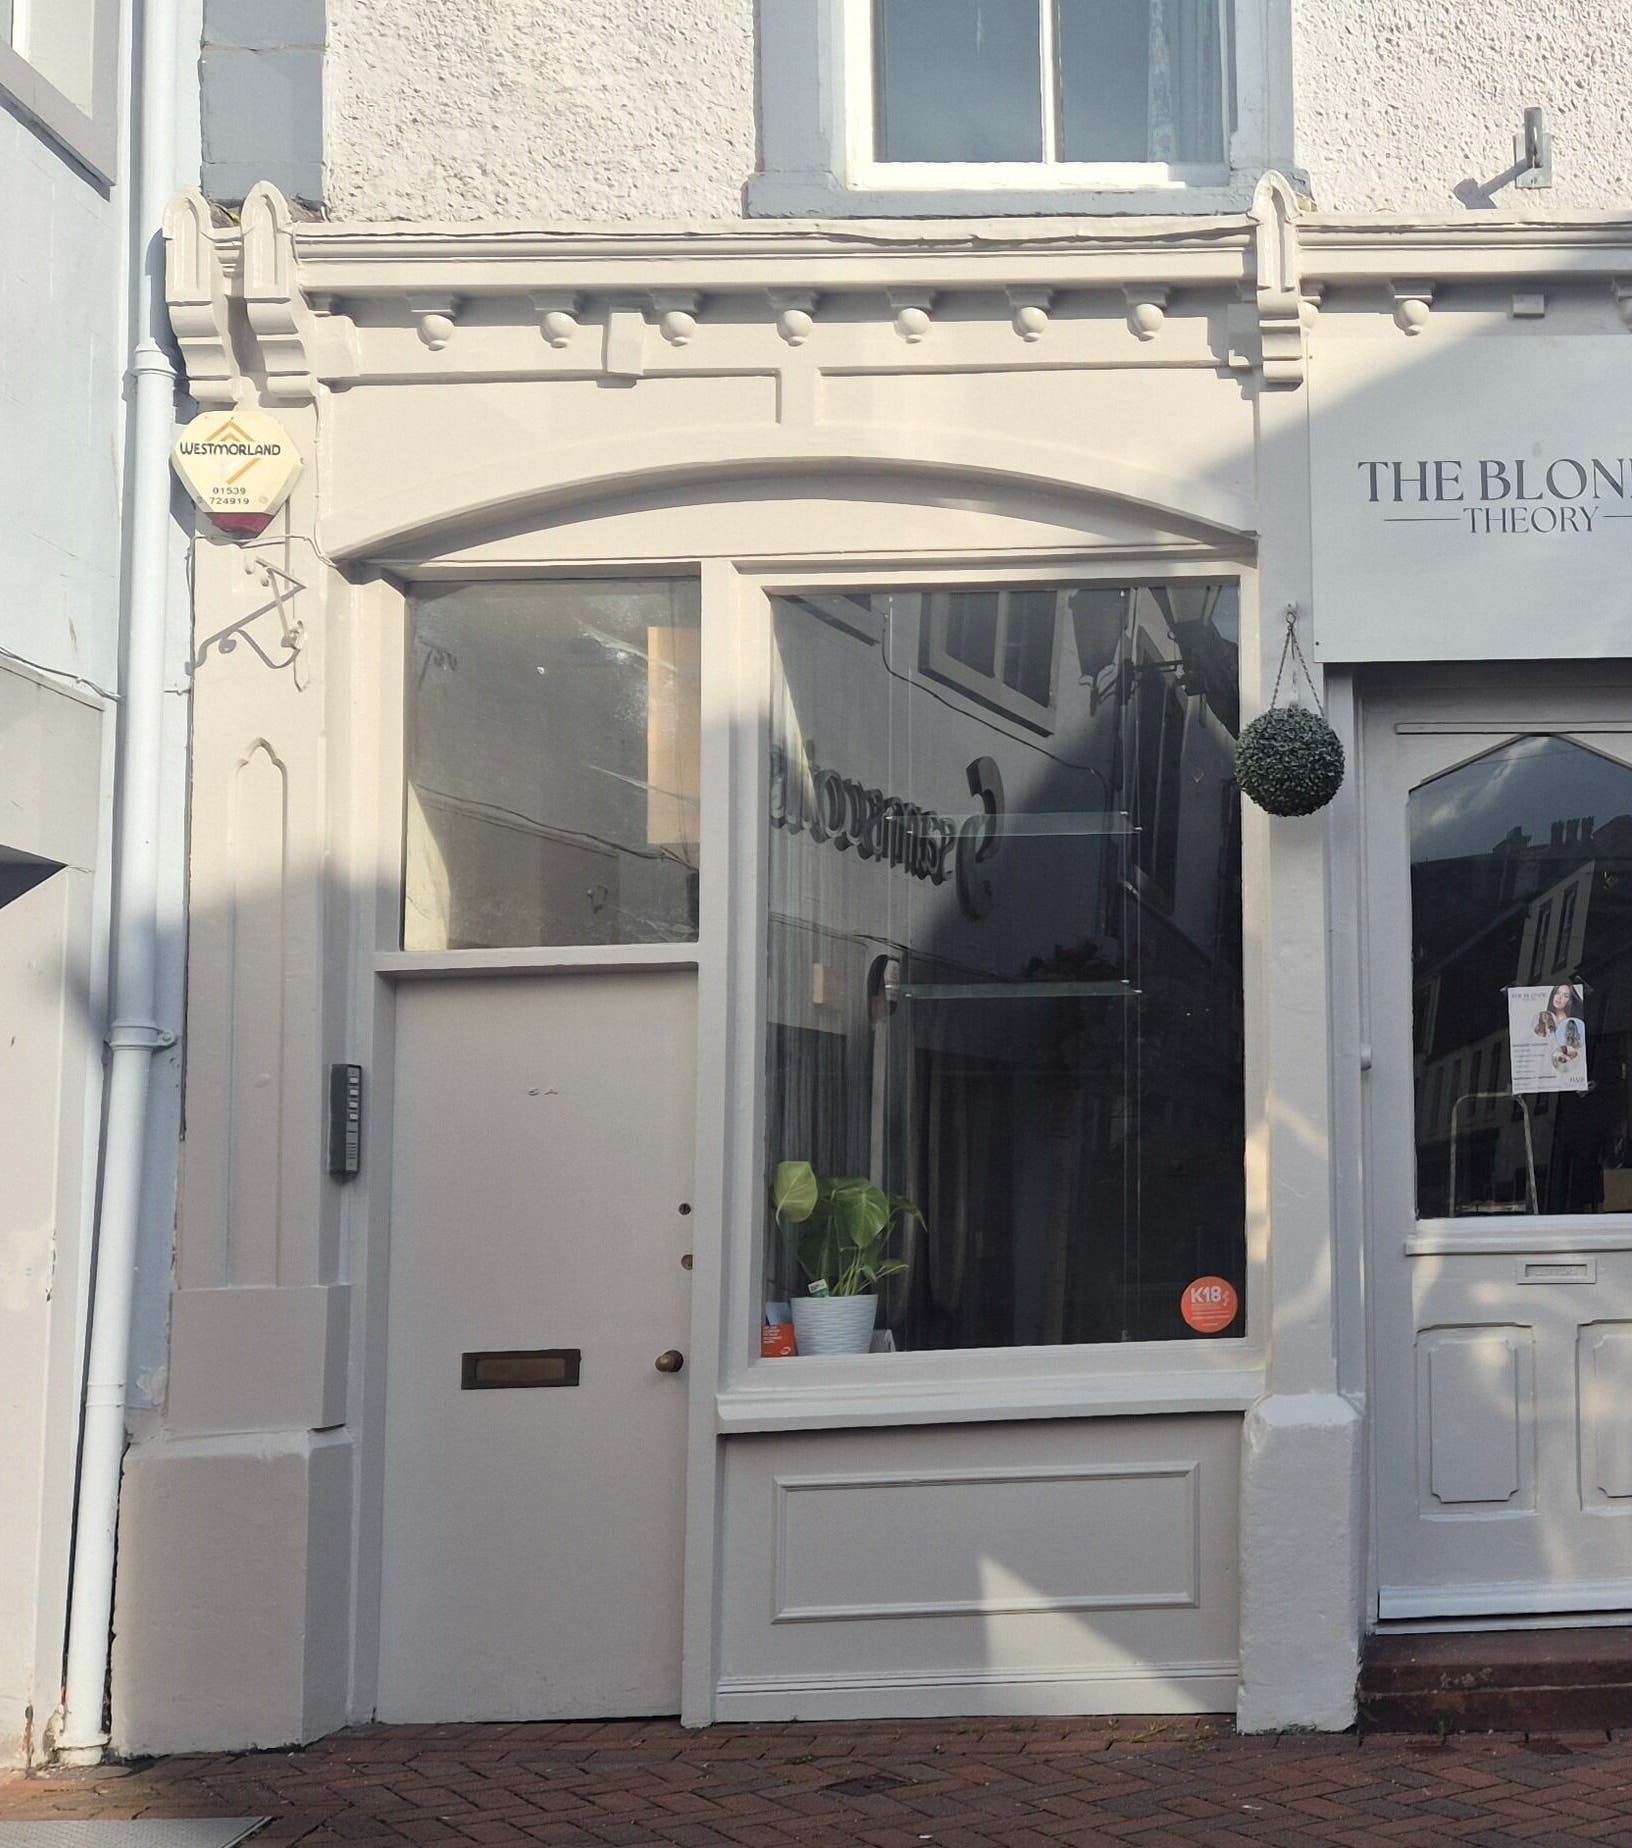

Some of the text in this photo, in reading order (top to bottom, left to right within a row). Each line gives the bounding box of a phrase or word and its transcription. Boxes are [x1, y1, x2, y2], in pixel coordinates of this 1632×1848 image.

[179, 442, 281, 456] WESTMORLAND
[1357, 460, 1464, 502] THE
[212, 487, 247, 495] 01539
[209, 496, 250, 505] 724919
[1463, 505, 1599, 534] THEORY
[1190, 1285, 1222, 1304] K18
